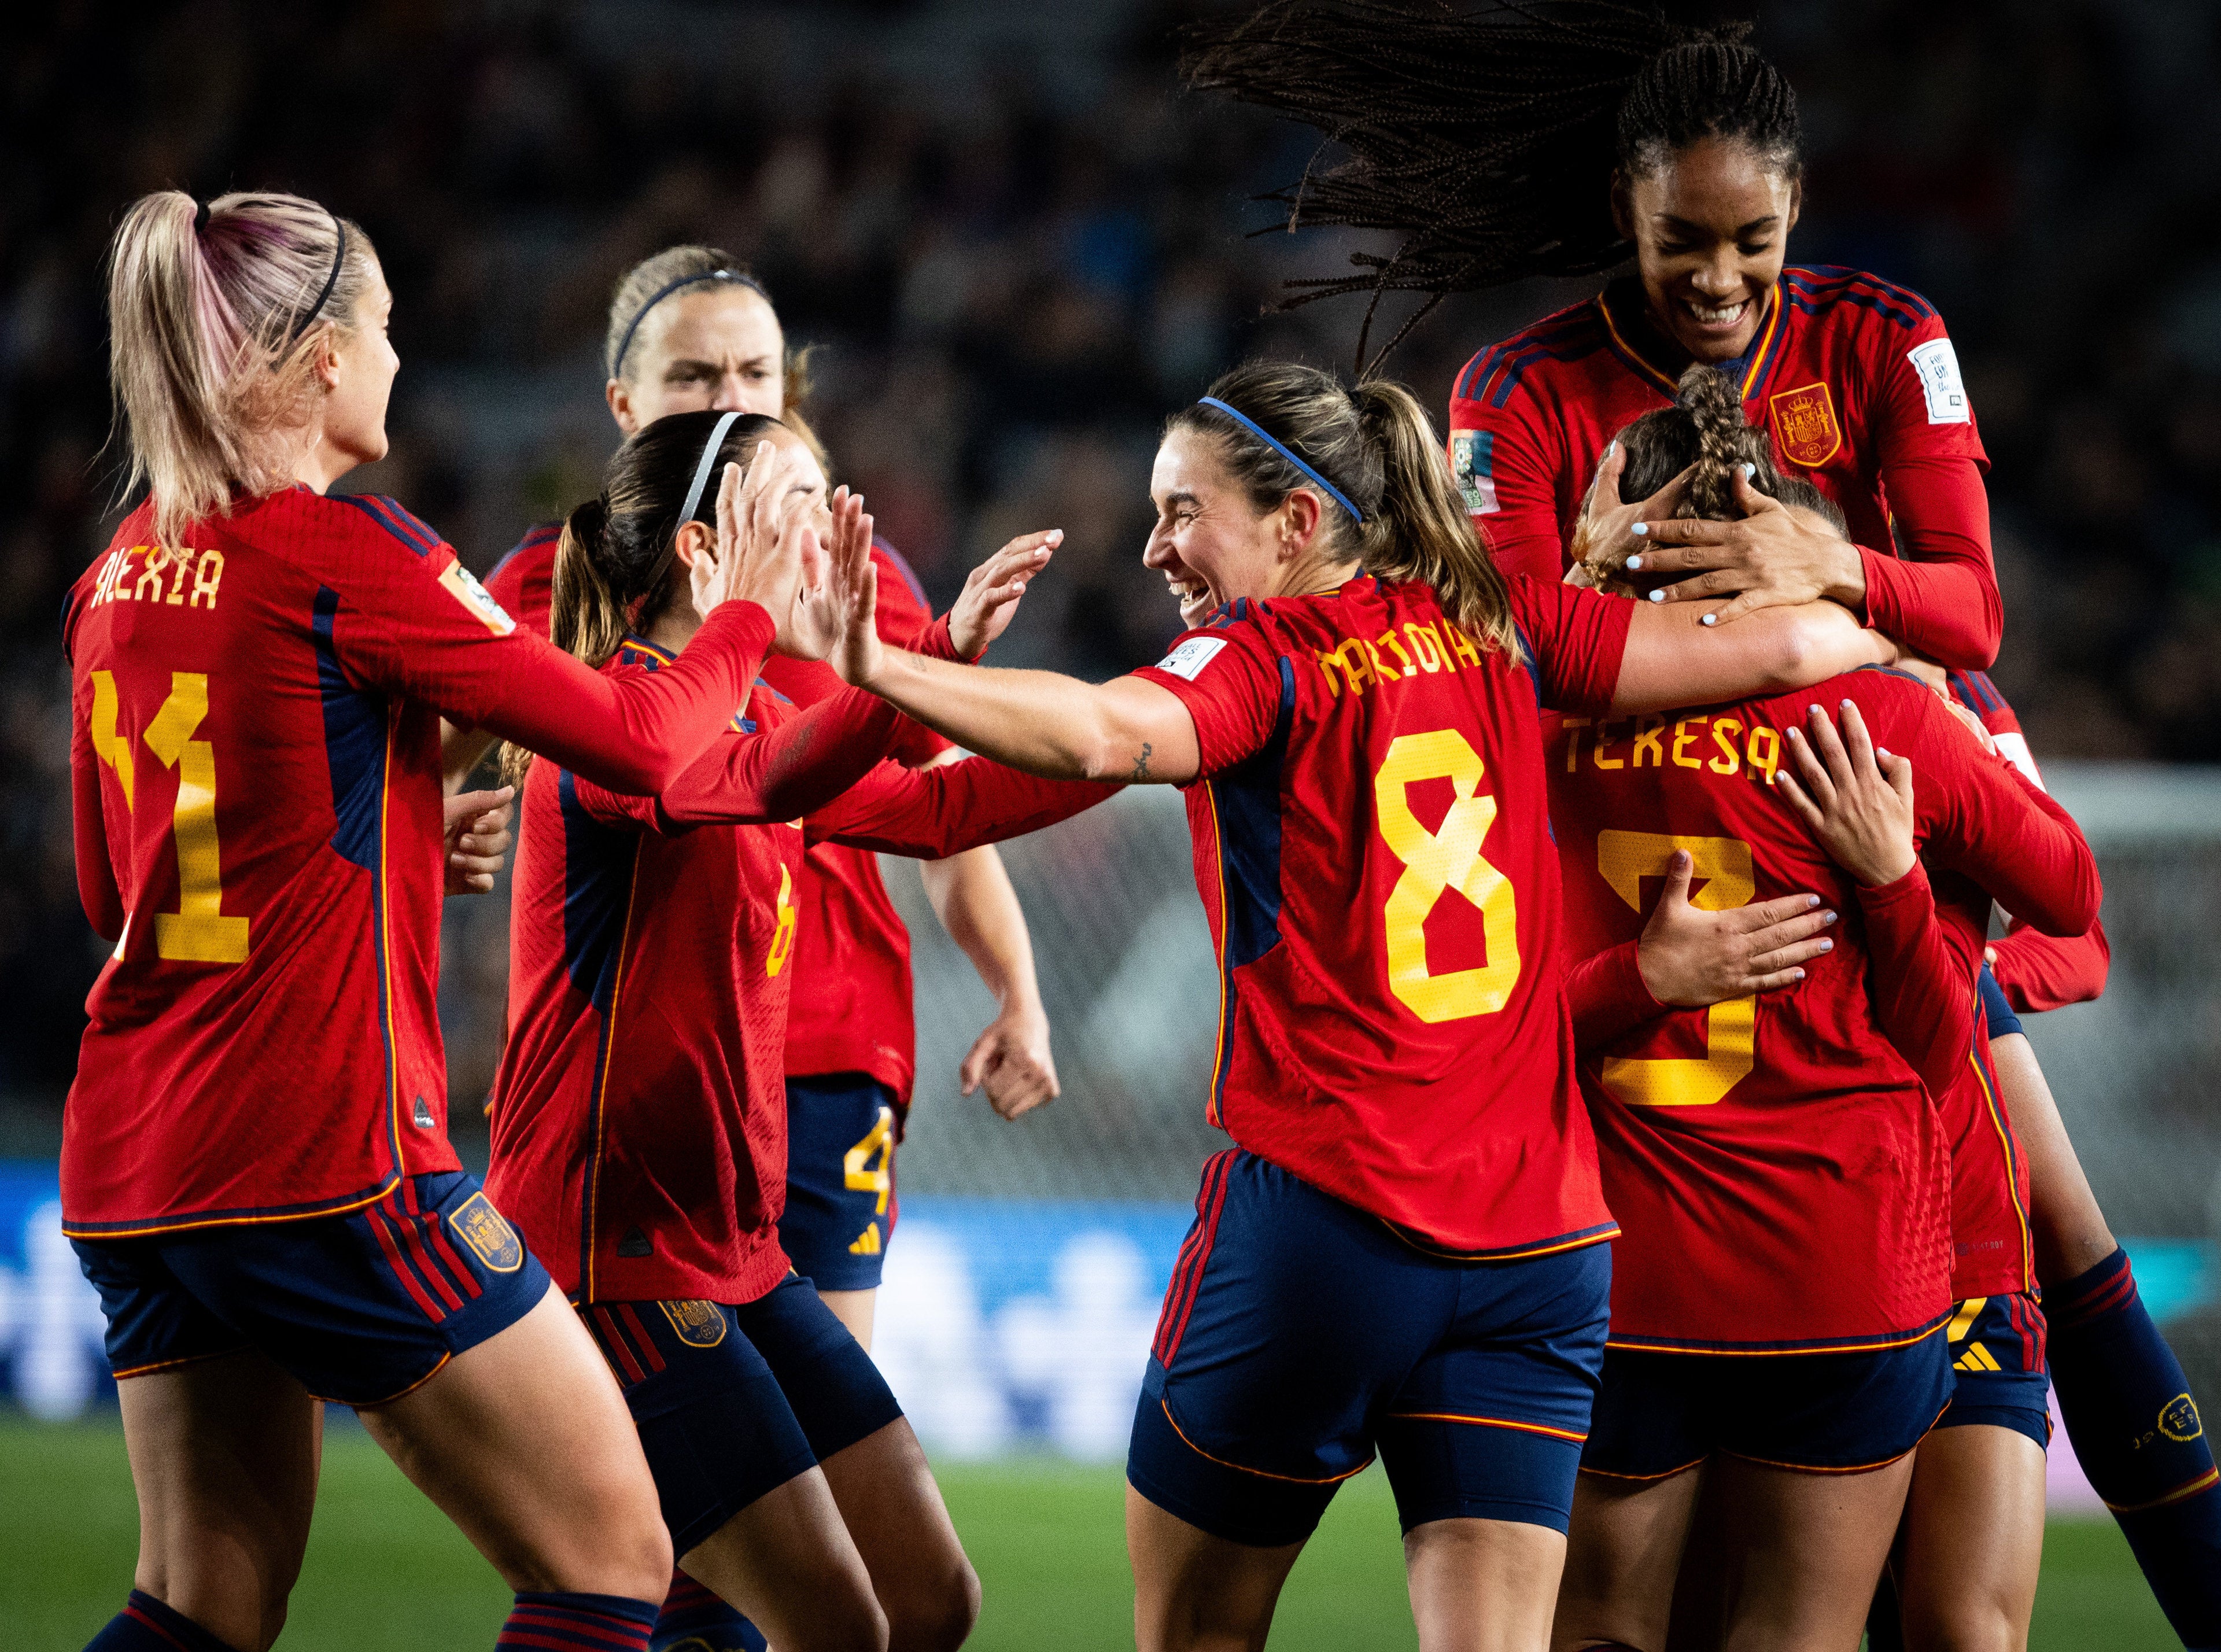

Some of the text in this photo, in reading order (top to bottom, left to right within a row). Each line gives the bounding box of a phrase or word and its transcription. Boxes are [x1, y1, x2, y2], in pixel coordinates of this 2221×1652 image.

[90, 545, 225, 610] ALEXIA
[1562, 712, 1780, 784] TERESA
[1374, 728, 1521, 1024] 8
[1598, 829, 1756, 1105] 3
[844, 1106, 891, 1215] 4
